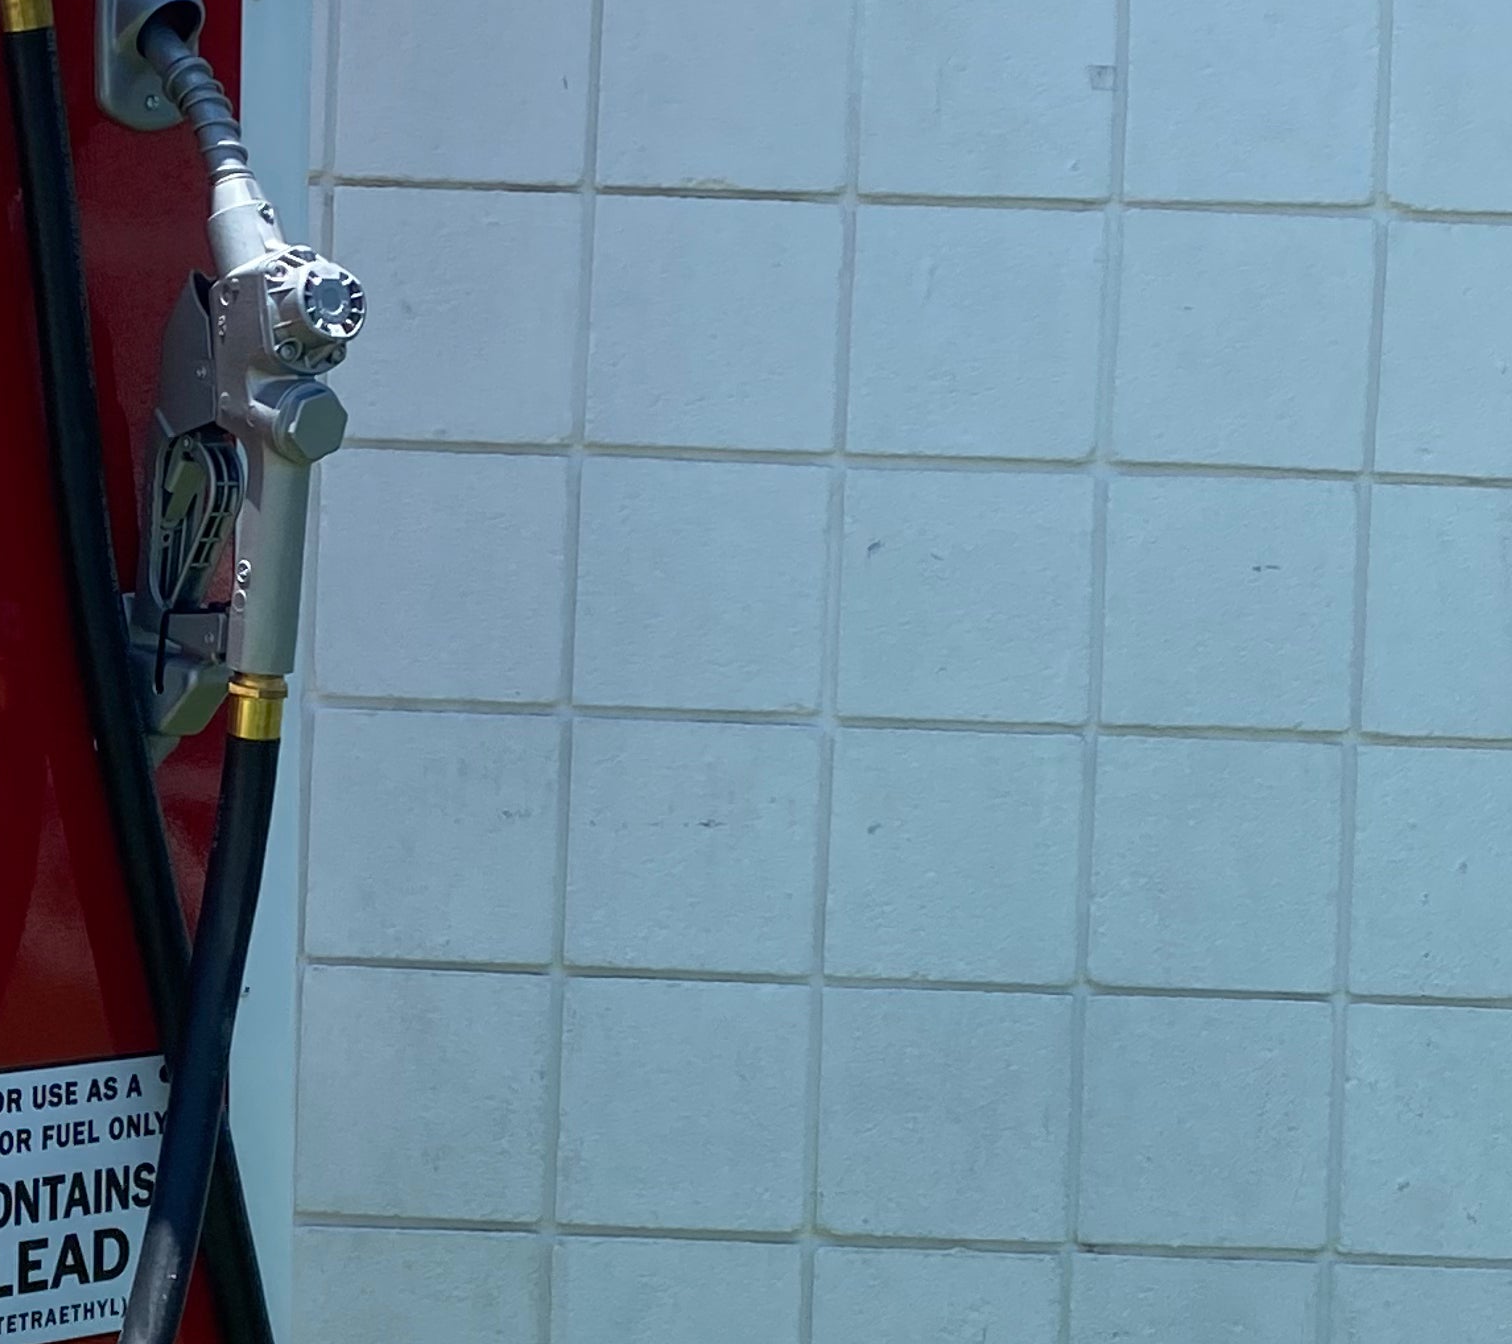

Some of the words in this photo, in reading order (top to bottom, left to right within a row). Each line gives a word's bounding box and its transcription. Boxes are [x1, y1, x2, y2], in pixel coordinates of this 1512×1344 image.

[32, 1081, 79, 1109] USE
[86, 1076, 119, 1103] AS
[125, 1074, 143, 1099] A
[41, 1120, 100, 1150] FUEL
[108, 1110, 167, 1141] ONLY
